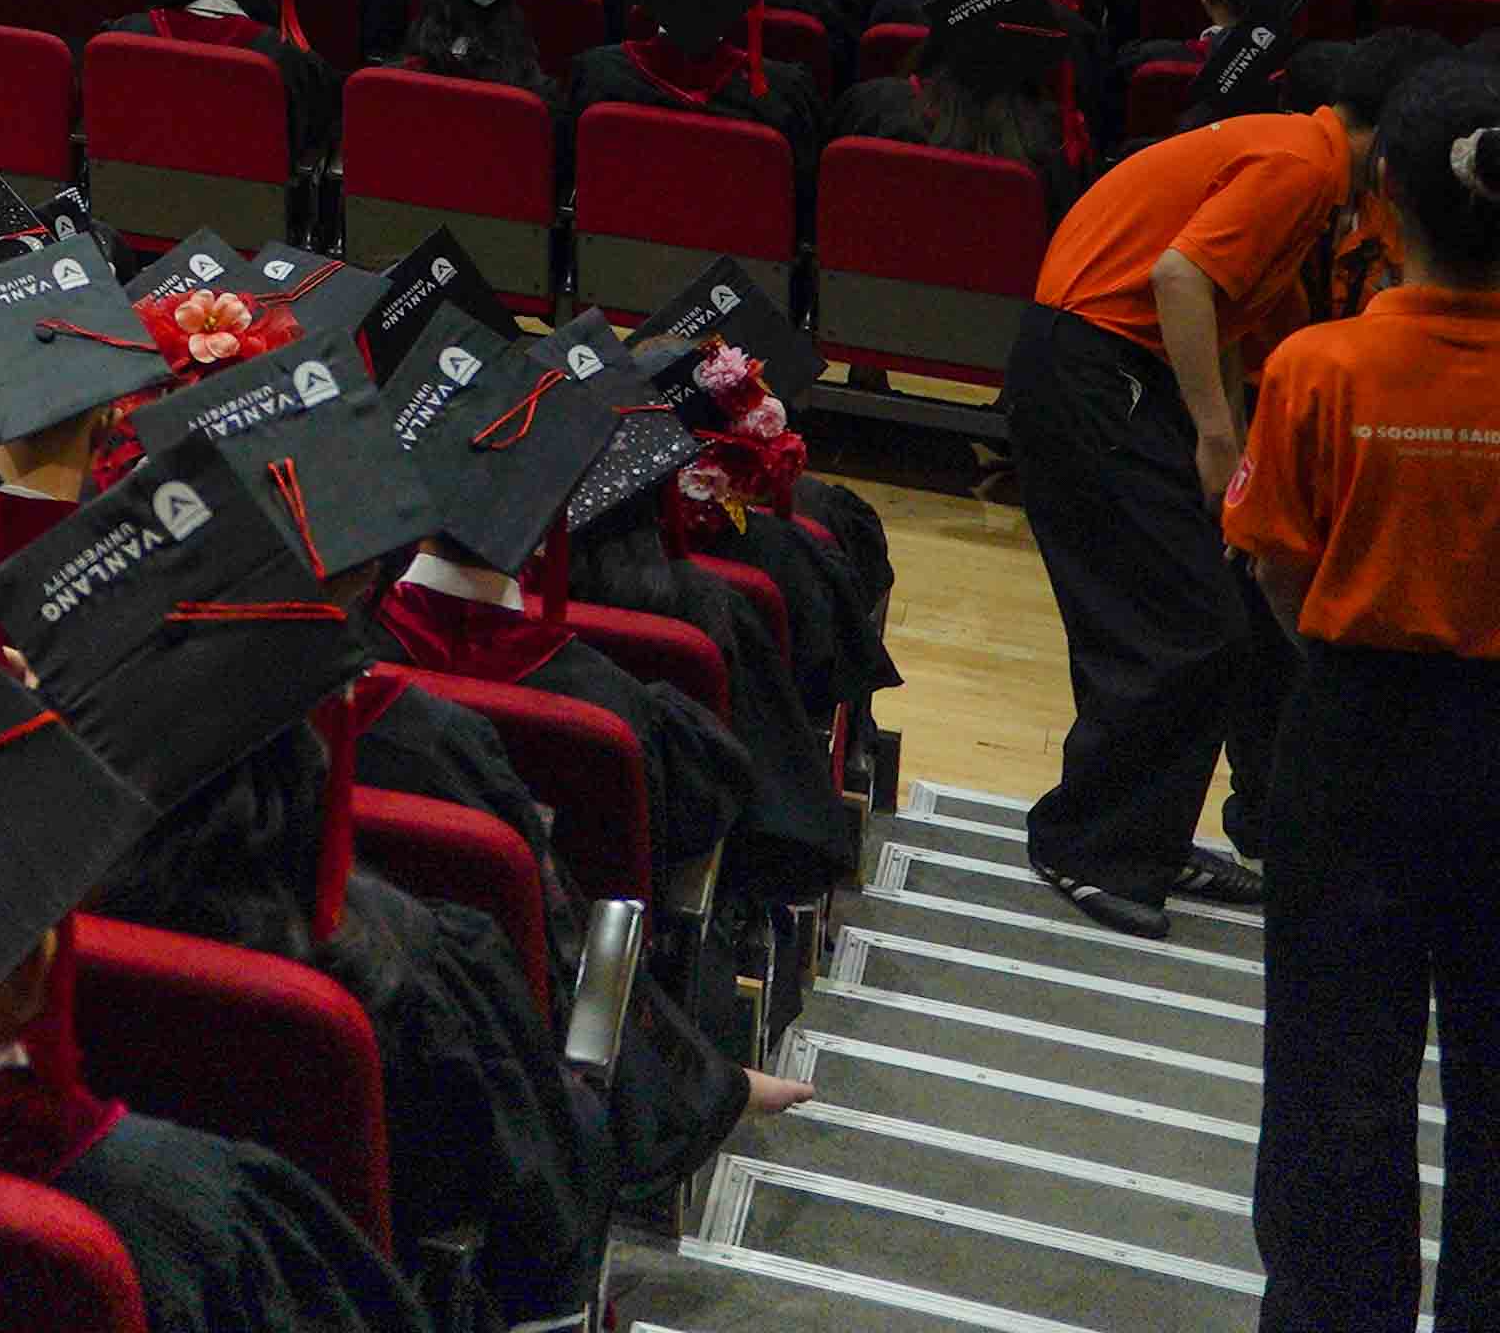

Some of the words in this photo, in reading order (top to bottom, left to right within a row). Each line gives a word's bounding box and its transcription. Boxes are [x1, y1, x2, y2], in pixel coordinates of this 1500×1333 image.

[1220, 42, 1263, 94] VANLANG
[382, 274, 441, 331] VANLANG
[188, 387, 273, 432] UNIVERSITY
[39, 528, 163, 623] VANLANG
[43, 521, 138, 595] UNIVERSITY
